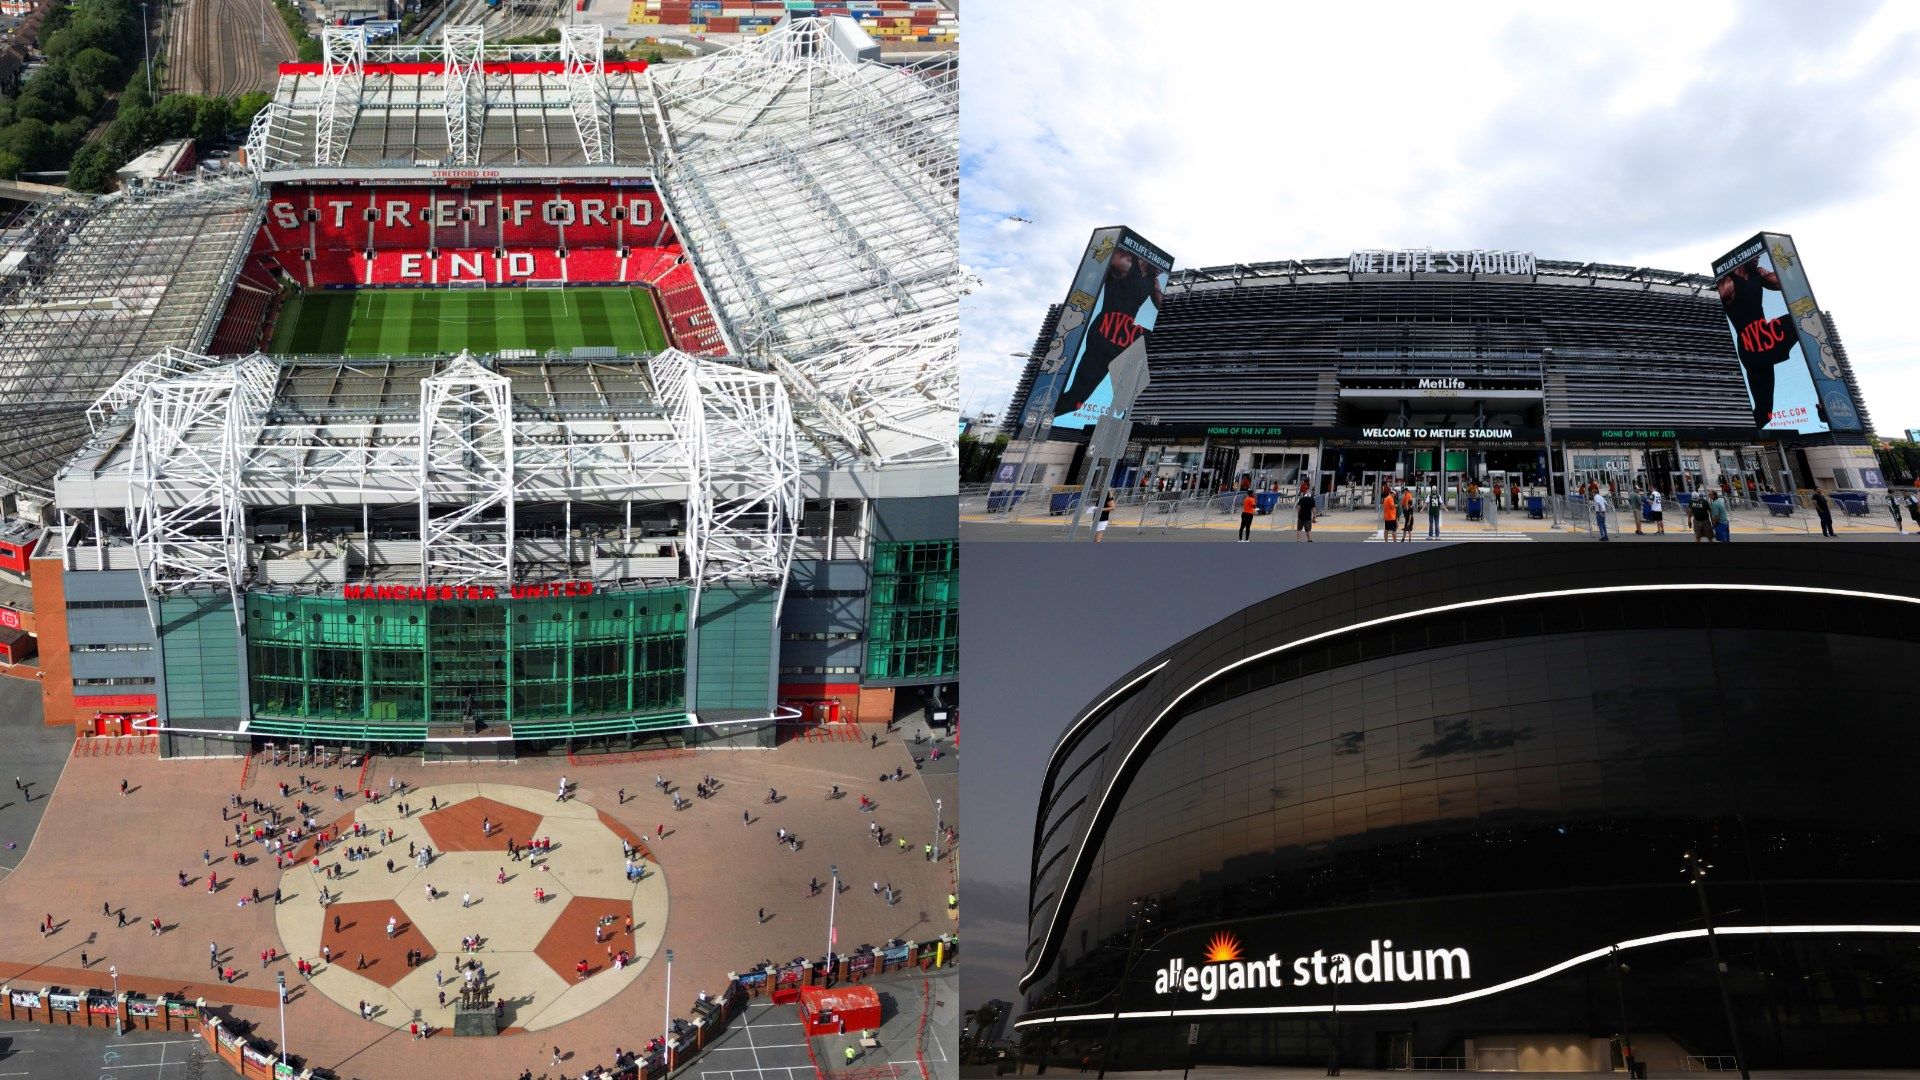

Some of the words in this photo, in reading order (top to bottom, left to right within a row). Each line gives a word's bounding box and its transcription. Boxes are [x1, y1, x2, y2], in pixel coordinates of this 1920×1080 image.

[431, 170, 479, 178] STRETFORD
[272, 199, 653, 229] STRETFORD
[1124, 236, 1149, 258] METLIFE
[1147, 251, 1171, 270] STADIUM
[1716, 257, 1738, 275] METLIFE
[1737, 241, 1763, 262] STADIUM
[401, 252, 535, 278] END
[1349, 251, 1437, 274] METLIFE
[1446, 250, 1537, 276] STADIUM
[1740, 316, 1785, 353] NYSC
[1418, 378, 1466, 389] MetLife
[1074, 401, 1111, 416] NYSC.CO
[1767, 406, 1807, 420] NYSC.COM
[1207, 427, 1229, 435] HOME
[1229, 427, 1240, 435] OF
[1241, 427, 1254, 435] THE
[1254, 427, 1266, 435] NY
[1266, 427, 1282, 435] JETS
[1362, 428, 1411, 438] WELCOME
[1413, 428, 1428, 438] TO
[1429, 428, 1467, 438] METLIFE
[1469, 428, 1513, 438] STADIUM
[1605, 461, 1630, 470] CLUB
[1683, 460, 1700, 470] LUB
[343, 583, 496, 601] MANCHESTER
[511, 580, 593, 600] UNITED
[1154, 953, 1283, 1002] allegiant
[1292, 938, 1472, 986] stadium
